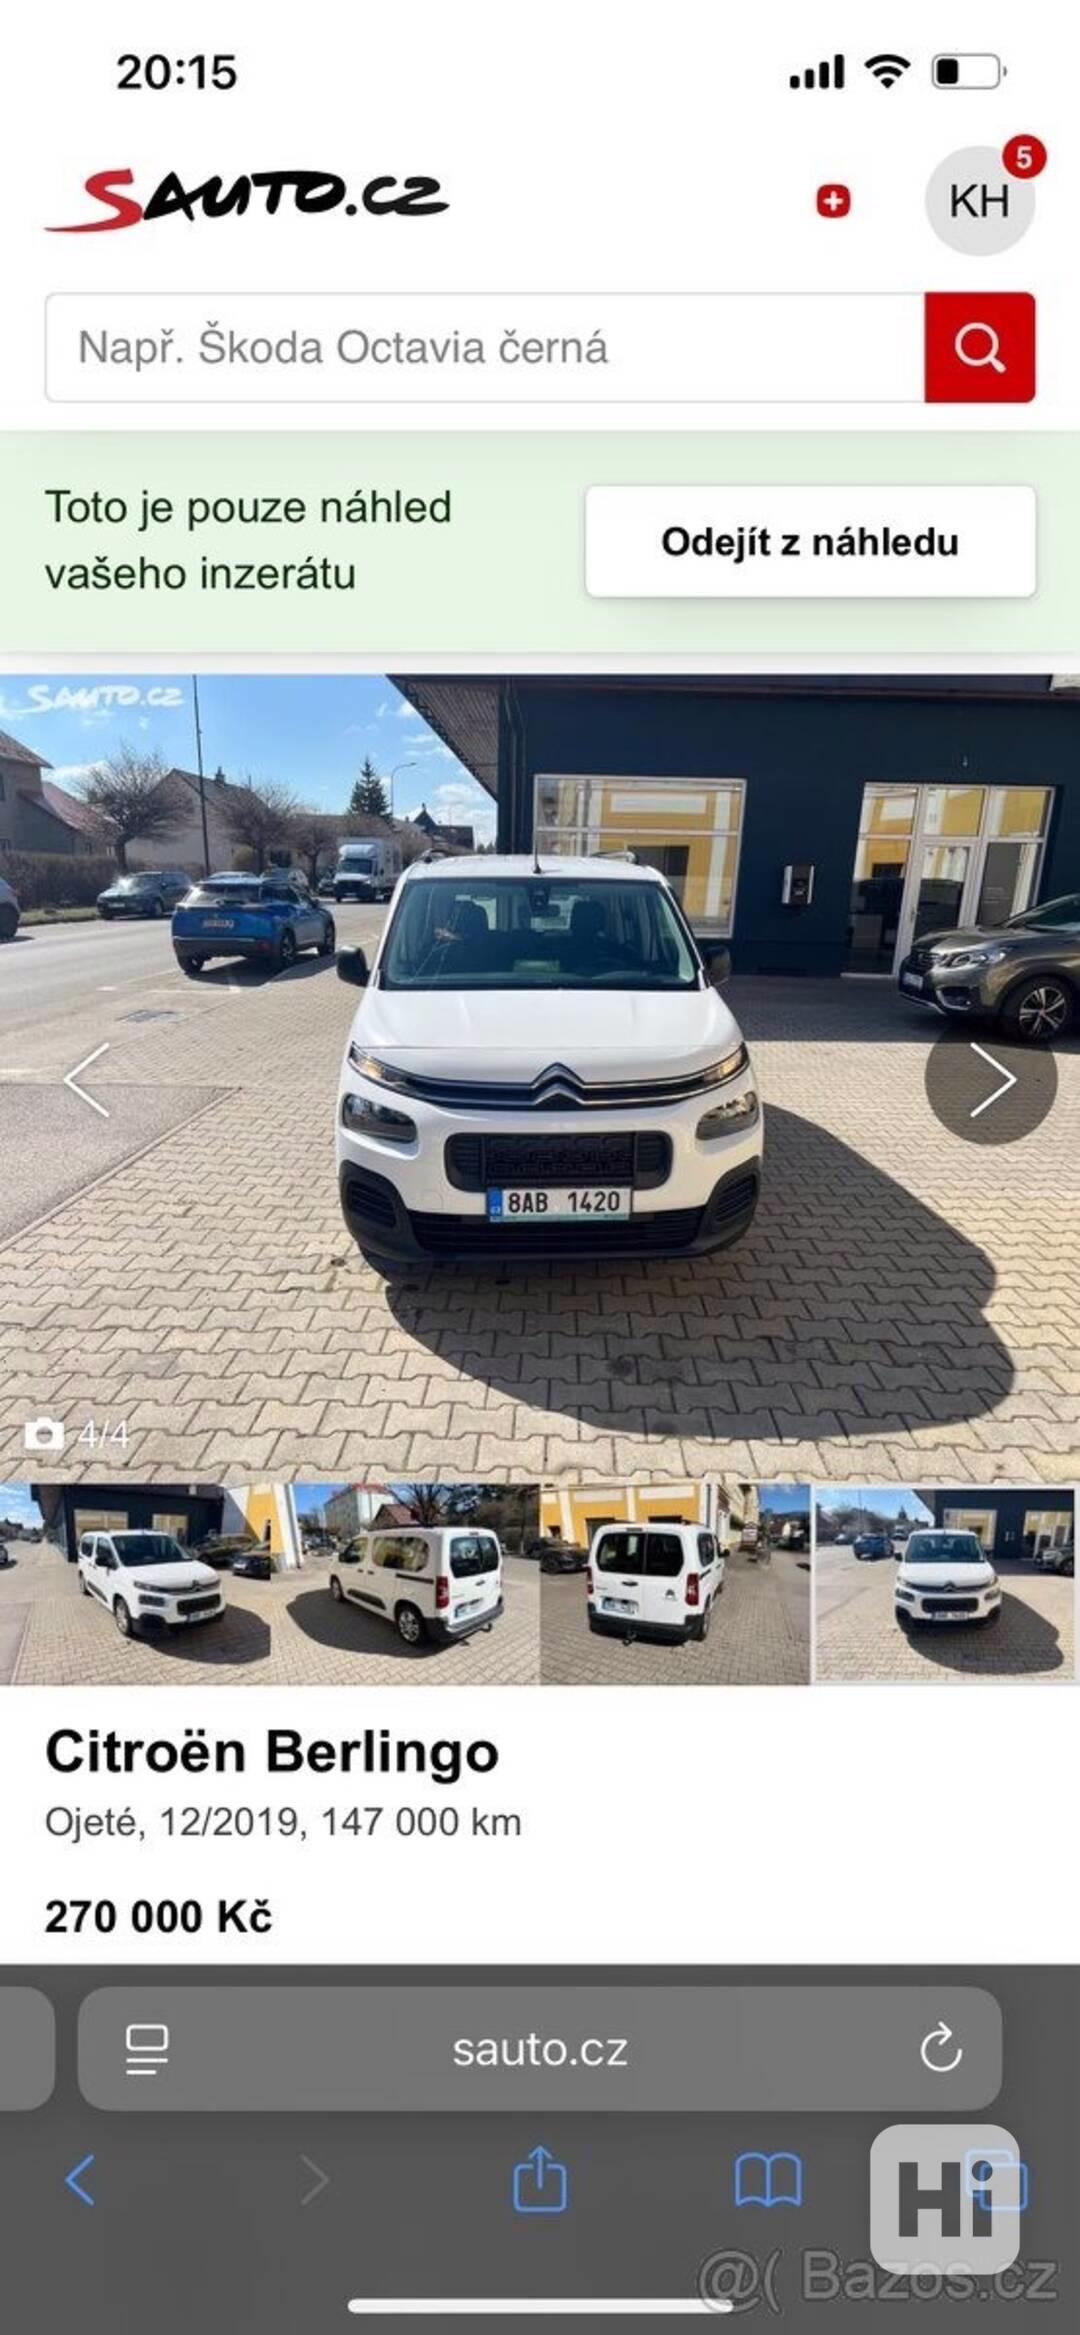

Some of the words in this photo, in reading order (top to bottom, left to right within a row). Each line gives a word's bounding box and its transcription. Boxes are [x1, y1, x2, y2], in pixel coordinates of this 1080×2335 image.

[116, 53, 238, 91] 20:15
[1016, 145, 1033, 170] 5
[950, 183, 1010, 218] KH
[78, 328, 184, 373] Např.
[198, 320, 324, 365] Škoda
[336, 328, 488, 365] Octavia
[498, 328, 609, 365] černá
[44, 489, 128, 524] Toto
[137, 489, 174, 532] je
[187, 497, 307, 533] pouze
[320, 488, 452, 524] náhled
[661, 525, 772, 566] Odejít
[780, 534, 802, 557] z
[812, 525, 960, 558] náhledu
[44, 555, 187, 591] vašeho
[200, 555, 355, 591] inzerátu
[508, 1191, 549, 1213] 8AB
[567, 1190, 620, 1212] 1420
[45, 1727, 246, 1775] Citroën
[267, 1728, 500, 1786] Berlingo
[45, 1806, 146, 1845] Ojeté,
[161, 1806, 307, 1843] 12/2019,
[322, 1806, 384, 1837] 147
[395, 1806, 460, 1837] 000
[472, 1806, 522, 1837] km
[44, 1898, 118, 1935] 270
[130, 1898, 203, 1935] 000
[218, 1898, 273, 1935] Kč
[453, 2032, 628, 2067] sauto.cz
